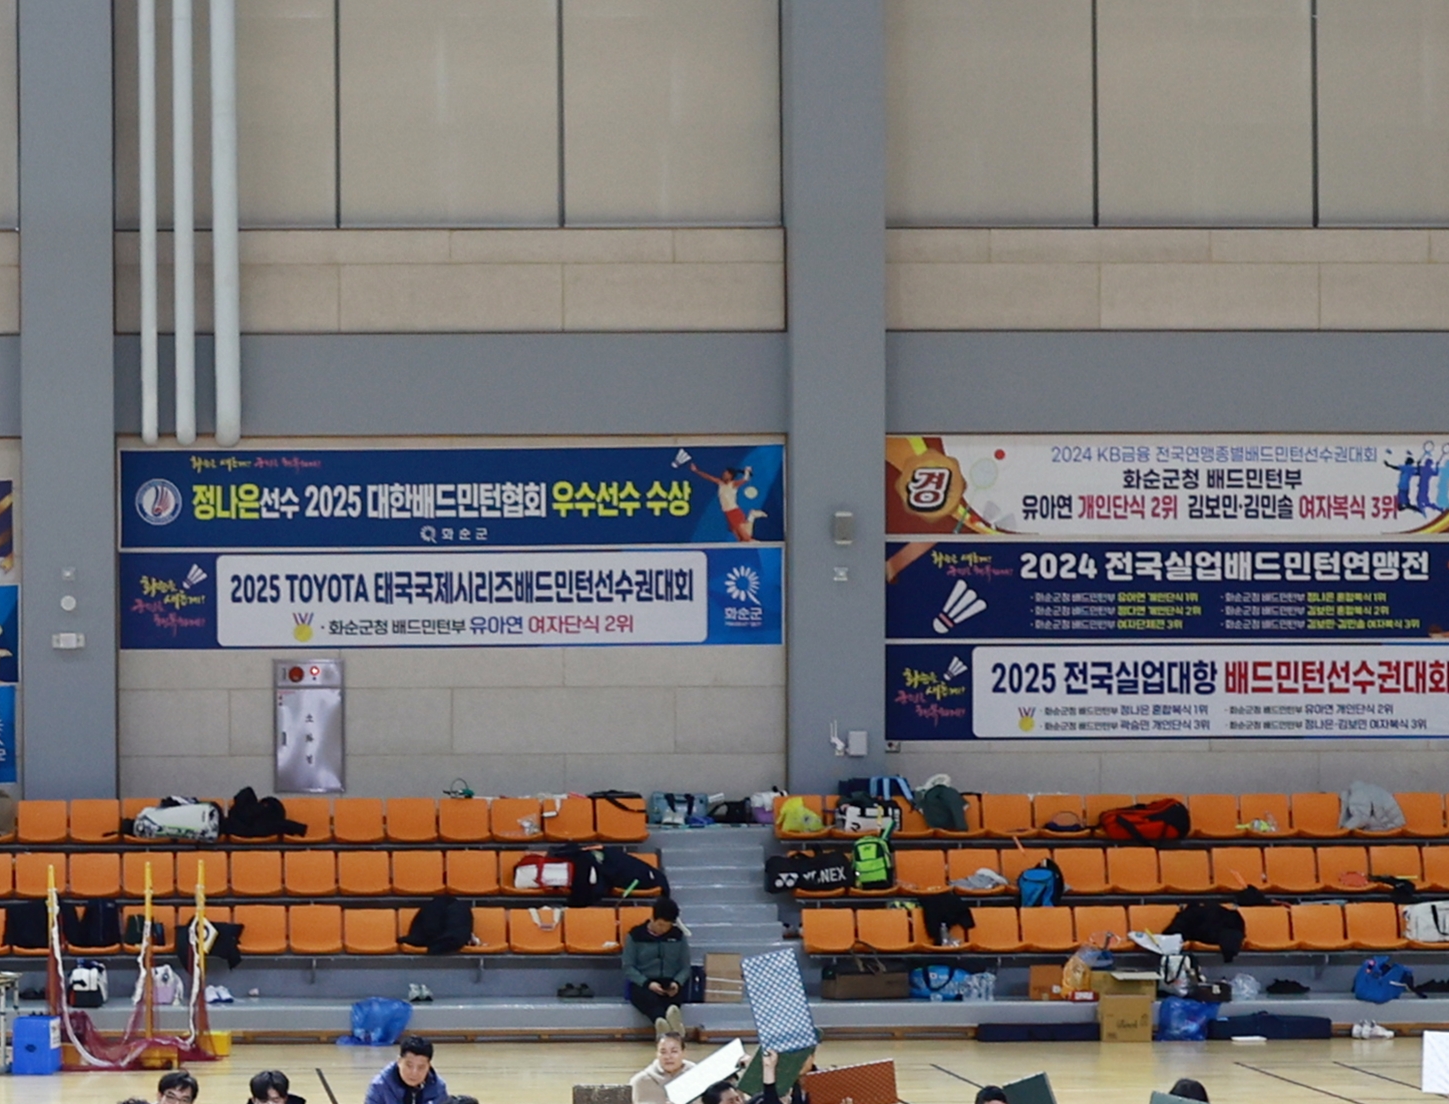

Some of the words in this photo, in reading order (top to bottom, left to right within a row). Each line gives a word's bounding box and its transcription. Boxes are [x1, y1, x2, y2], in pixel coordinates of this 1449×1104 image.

[1051, 447, 1092, 463] 2024
[1097, 447, 1151, 463] KB금융
[1155, 446, 1377, 463] 전국연맹종별배드민턴선수권대회
[908, 468, 950, 507] 경
[1122, 469, 1200, 490] 화순군청
[1206, 468, 1303, 490] 배드민턴부
[192, 484, 300, 520] 정나은선수
[304, 484, 362, 518] 2025
[367, 482, 546, 519] 대한배드민턴협회
[551, 480, 641, 517] 우수선수
[646, 480, 691, 517] 수상
[1022, 494, 1074, 521] 유아연
[1077, 494, 1146, 520] 개인단식
[1151, 494, 1179, 520] 2위
[1299, 494, 1367, 520] 여자복식
[1370, 494, 1400, 520] 3위
[1020, 552, 1098, 580] 2024
[1105, 550, 1430, 582] 전국실업배드민턴연맹전
[231, 573, 280, 603] 2025
[285, 573, 367, 603] TOYOTA
[374, 569, 693, 604] 태국국제시리즈배드민턴선수권대회
[328, 620, 388, 635] 화순군청
[392, 619, 466, 635] 배드민턴부
[469, 616, 524, 634] 유아연
[528, 615, 600, 634] 여자단식
[604, 615, 634, 633] 2위
[991, 662, 1056, 694] 2025
[1063, 659, 1218, 695] 전국실업대항
